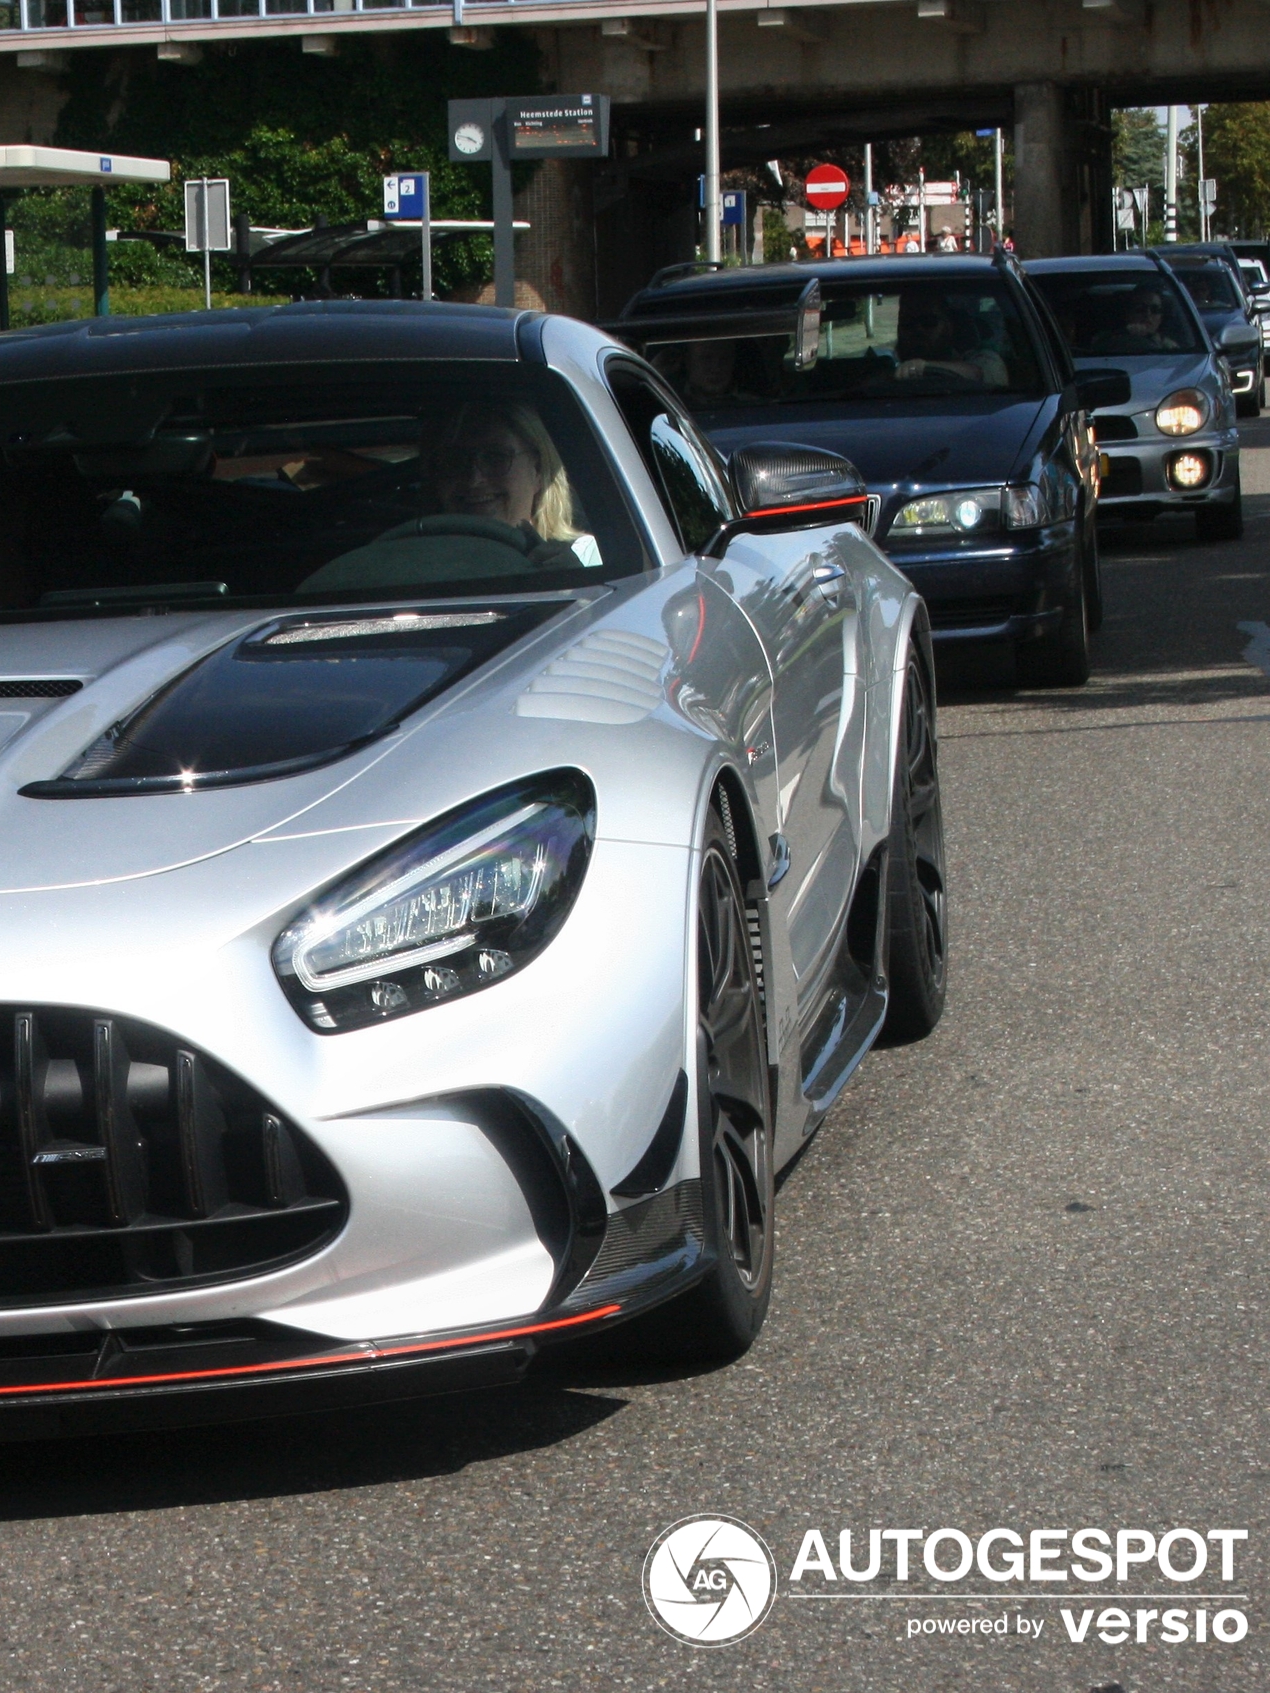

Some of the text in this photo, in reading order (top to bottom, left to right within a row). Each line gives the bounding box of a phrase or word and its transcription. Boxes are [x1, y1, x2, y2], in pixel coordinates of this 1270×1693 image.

[520, 108, 593, 119] Heemstede Station
[404, 185, 410, 193] 2
